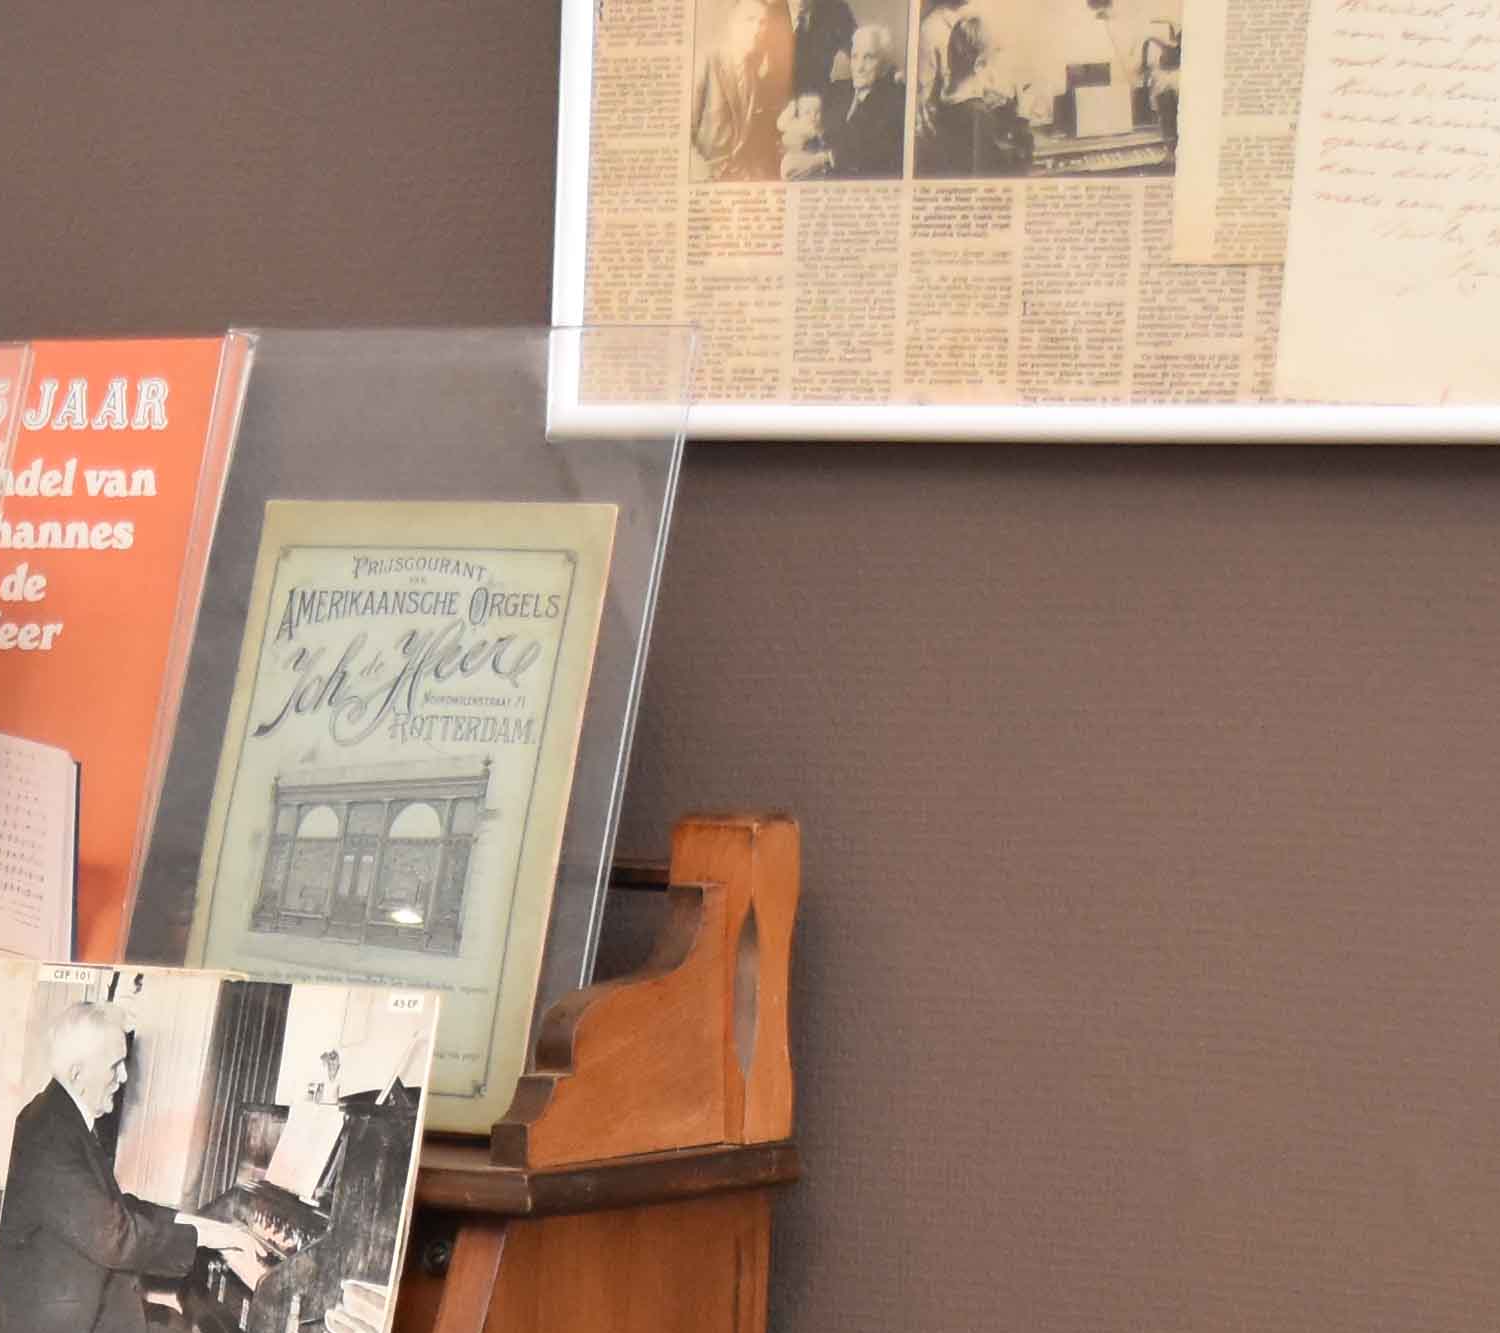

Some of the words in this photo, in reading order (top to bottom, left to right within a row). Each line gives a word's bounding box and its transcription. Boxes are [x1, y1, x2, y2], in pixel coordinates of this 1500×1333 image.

[22, 376, 169, 431] JAAR
[83, 467, 157, 497] van
[0, 561, 47, 602] de
[276, 586, 460, 641] AMERIKAANSCHE
[468, 585, 561, 626] ORGELS
[360, 651, 385, 679] de
